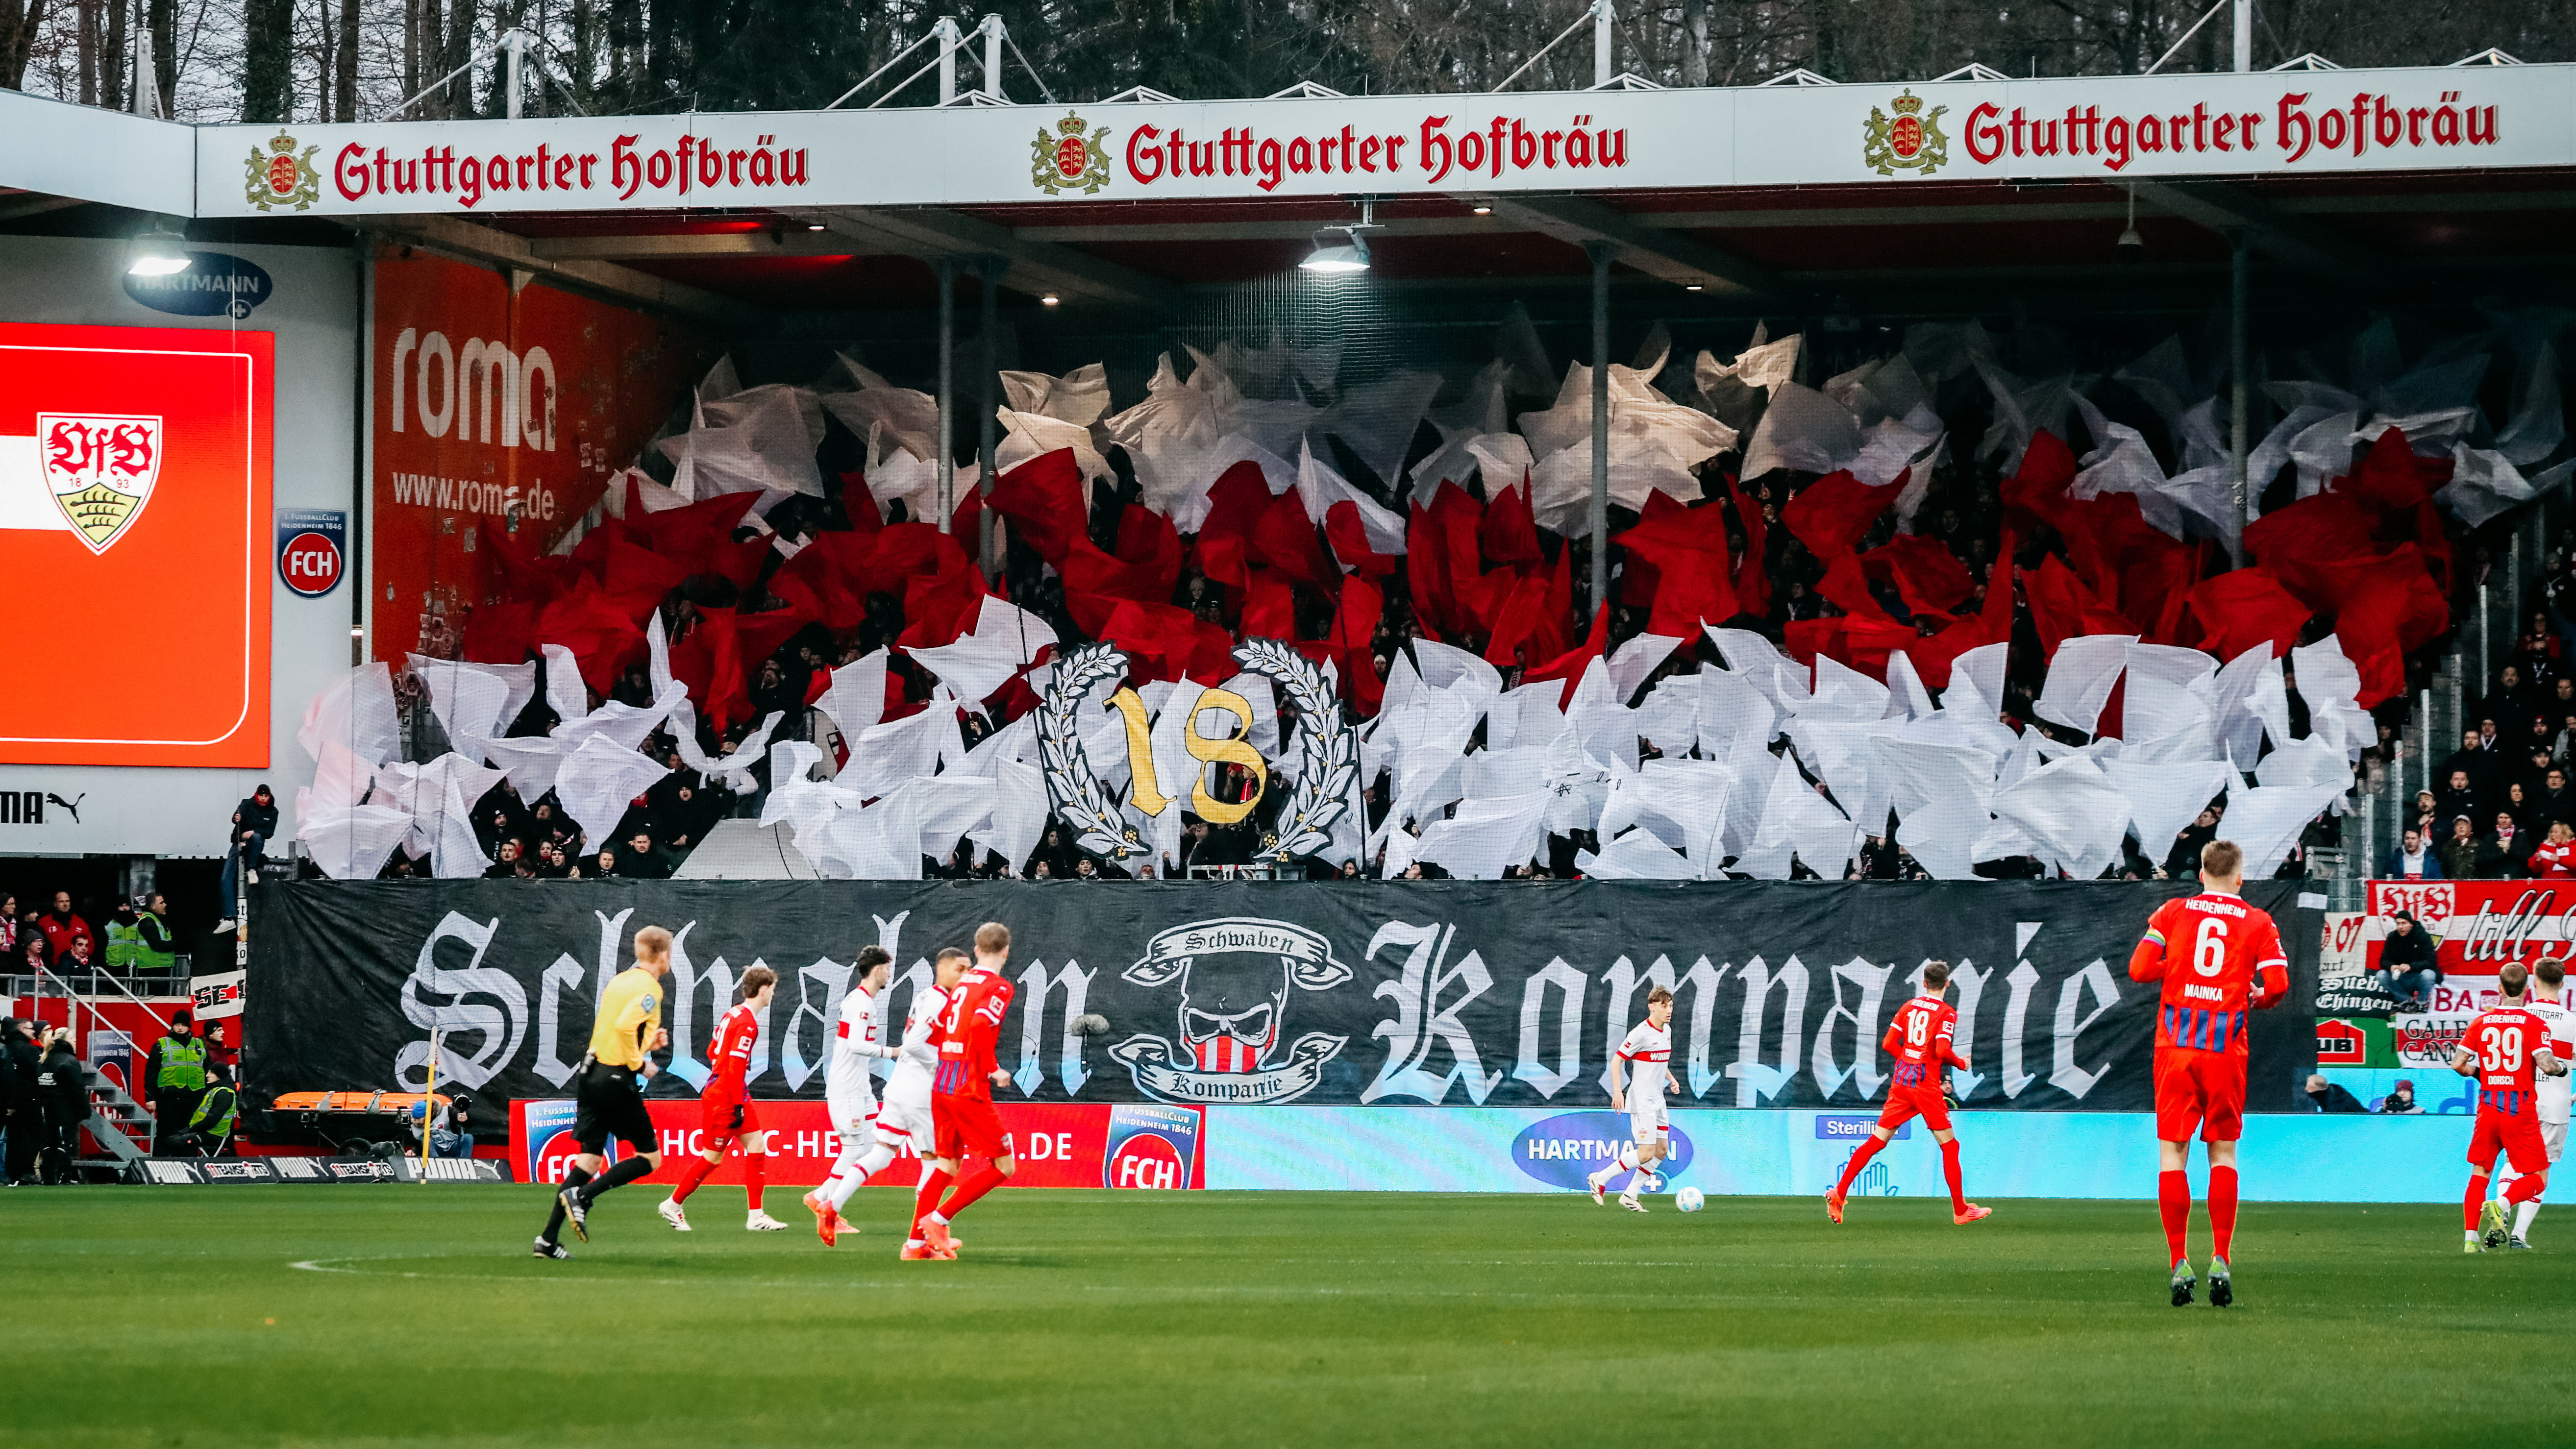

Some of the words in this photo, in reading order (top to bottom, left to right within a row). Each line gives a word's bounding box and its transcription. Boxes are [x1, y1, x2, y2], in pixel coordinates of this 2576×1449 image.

[1965, 101, 2263, 172] Stuttgarter
[2277, 91, 2499, 163] Hofbräu
[1126, 123, 1408, 192] Stuttgarter
[1419, 115, 1628, 184] Hofbräu
[335, 141, 599, 209] Stuttgarter
[612, 134, 809, 201] Hofbräu
[393, 327, 556, 451] roma
[69, 478, 82, 487] 18
[116, 479, 129, 489] 93
[291, 551, 332, 576] FCH
[1102, 687, 1267, 824] 18
[2185, 899, 2247, 919] HEIDENHEIM
[2463, 888, 2555, 962] till
[1185, 931, 1295, 953] Schwaben
[2193, 917, 2228, 978] 6
[2322, 958, 2345, 971] art
[2184, 983, 2223, 1002] MAINKA
[946, 986, 968, 1034] 3
[2482, 1014, 2527, 1025] HEIDENHEIM
[2526, 1008, 2564, 1021] TUTTGART
[1907, 1008, 1929, 1046] 18
[2405, 1019, 2468, 1039] GALE
[2481, 1027, 2523, 1072] 39
[1170, 1073, 1283, 1101] Kompanie
[2488, 1076, 2515, 1085] DORSCH
[544, 1106, 578, 1116] FUSSBA
[532, 1117, 578, 1128] HEIDENHE
[1115, 1115, 1169, 1131] HEIDENHEIM
[1171, 1124, 1192, 1135] 1846
[1827, 1120, 1898, 1135] Sterilli
[404, 1157, 476, 1179] PUMA
[1120, 1154, 1175, 1190] FCH
